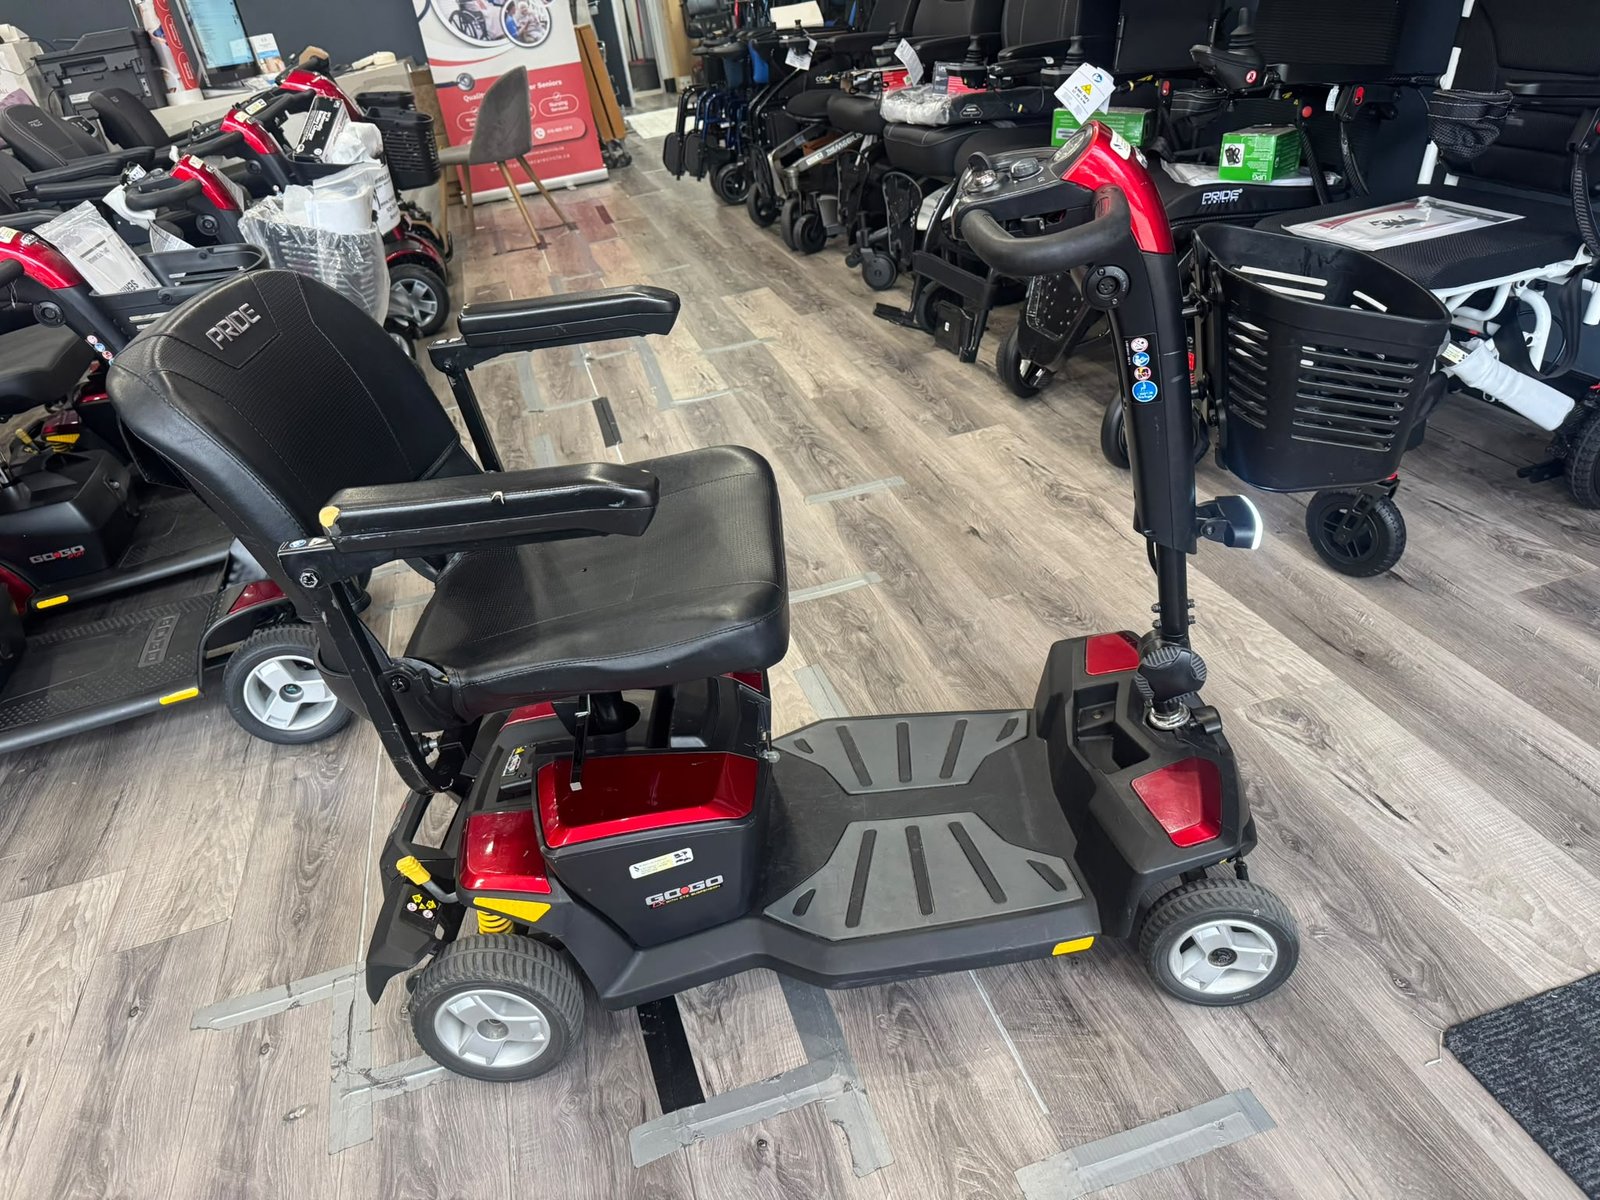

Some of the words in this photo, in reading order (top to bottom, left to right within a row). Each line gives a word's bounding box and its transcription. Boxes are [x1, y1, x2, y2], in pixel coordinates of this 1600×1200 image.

[537, 80, 562, 89] Seniors
[1203, 189, 1240, 202] PRIDE
[206, 303, 261, 350] PRIDE
